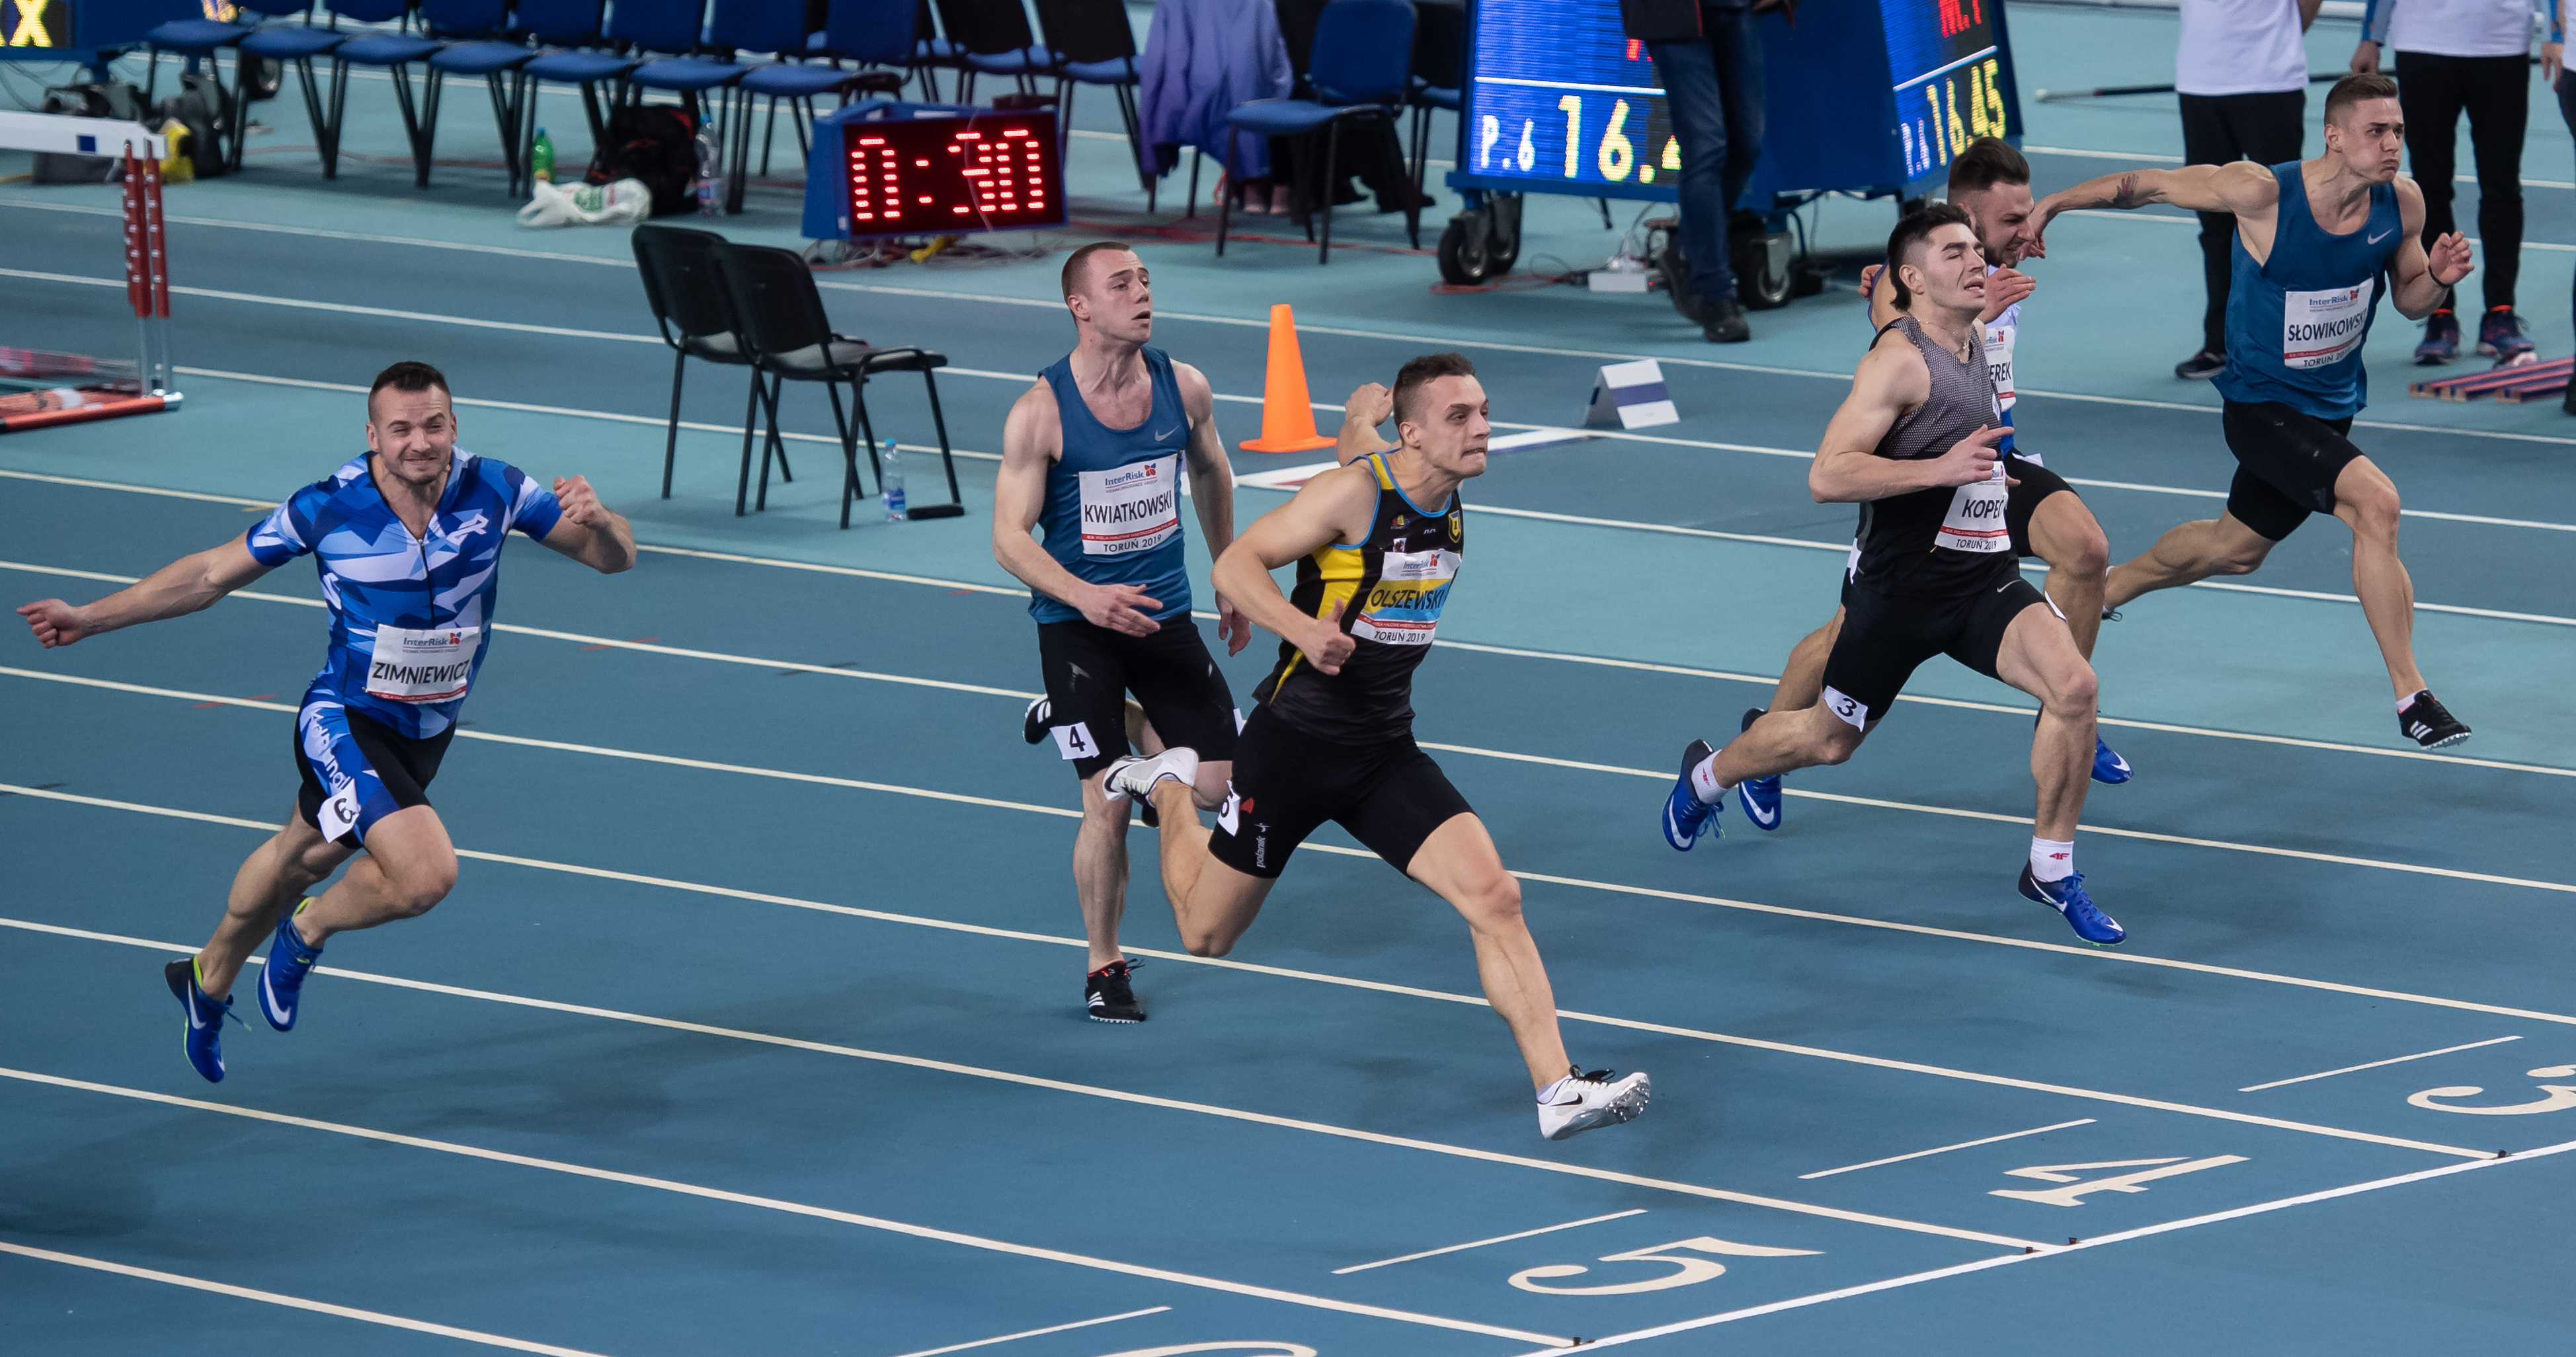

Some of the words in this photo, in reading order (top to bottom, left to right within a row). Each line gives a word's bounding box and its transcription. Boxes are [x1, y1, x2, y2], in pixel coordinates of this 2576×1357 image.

[0, 0, 53, 47] X
[1480, 115, 1535, 172] P.6
[2310, 295, 2348, 305] InterRisk
[1988, 362, 2011, 383] EREK
[1105, 471, 1144, 486] InterRisk
[1084, 490, 1172, 523] KWIATKOWSKI
[1104, 539, 1139, 553] TORUŃ
[1142, 534, 1162, 548] 2019
[1371, 589, 1445, 610] OLSZEWSKI
[403, 637, 448, 646] InterRisk
[1374, 630, 1404, 642] TORUŃ
[1406, 633, 1426, 642] 2019
[372, 659, 469, 684] ZIMNIEWICZ
[1837, 697, 1857, 717] 3
[1069, 726, 1086, 752] 4
[334, 798, 356, 824] 6
[1987, 1154, 2251, 1207] 4
[1508, 1236, 1825, 1296] 5
